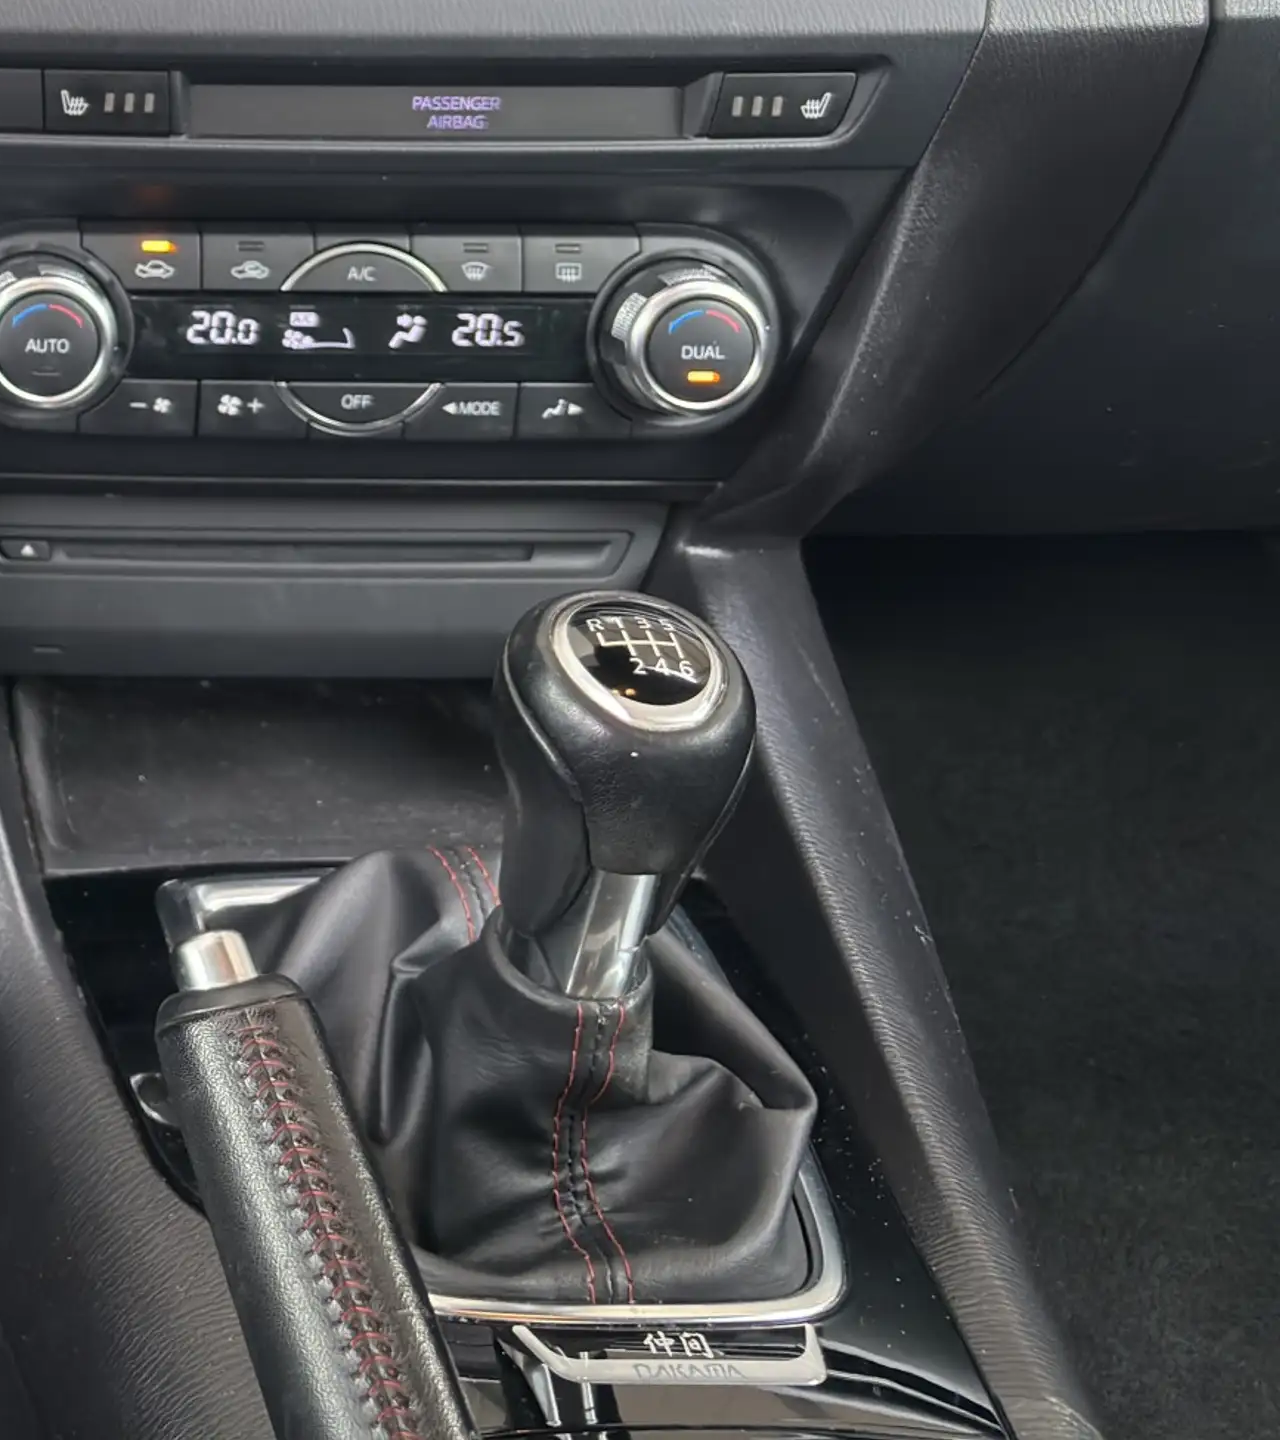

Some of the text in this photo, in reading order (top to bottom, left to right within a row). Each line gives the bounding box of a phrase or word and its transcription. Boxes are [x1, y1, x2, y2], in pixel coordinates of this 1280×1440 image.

[412, 96, 501, 110] PASSENGER
[427, 115, 488, 129] AIRBAG
[347, 267, 376, 282] A/C
[186, 310, 260, 346] 20.0
[451, 312, 526, 348] 20.5
[25, 338, 70, 355] AUTO
[681, 344, 726, 361] DUAL
[341, 394, 374, 409] OFF
[458, 401, 501, 417] MODE
[586, 617, 676, 632] R 1 3 5
[629, 658, 696, 677] 2 4 6
